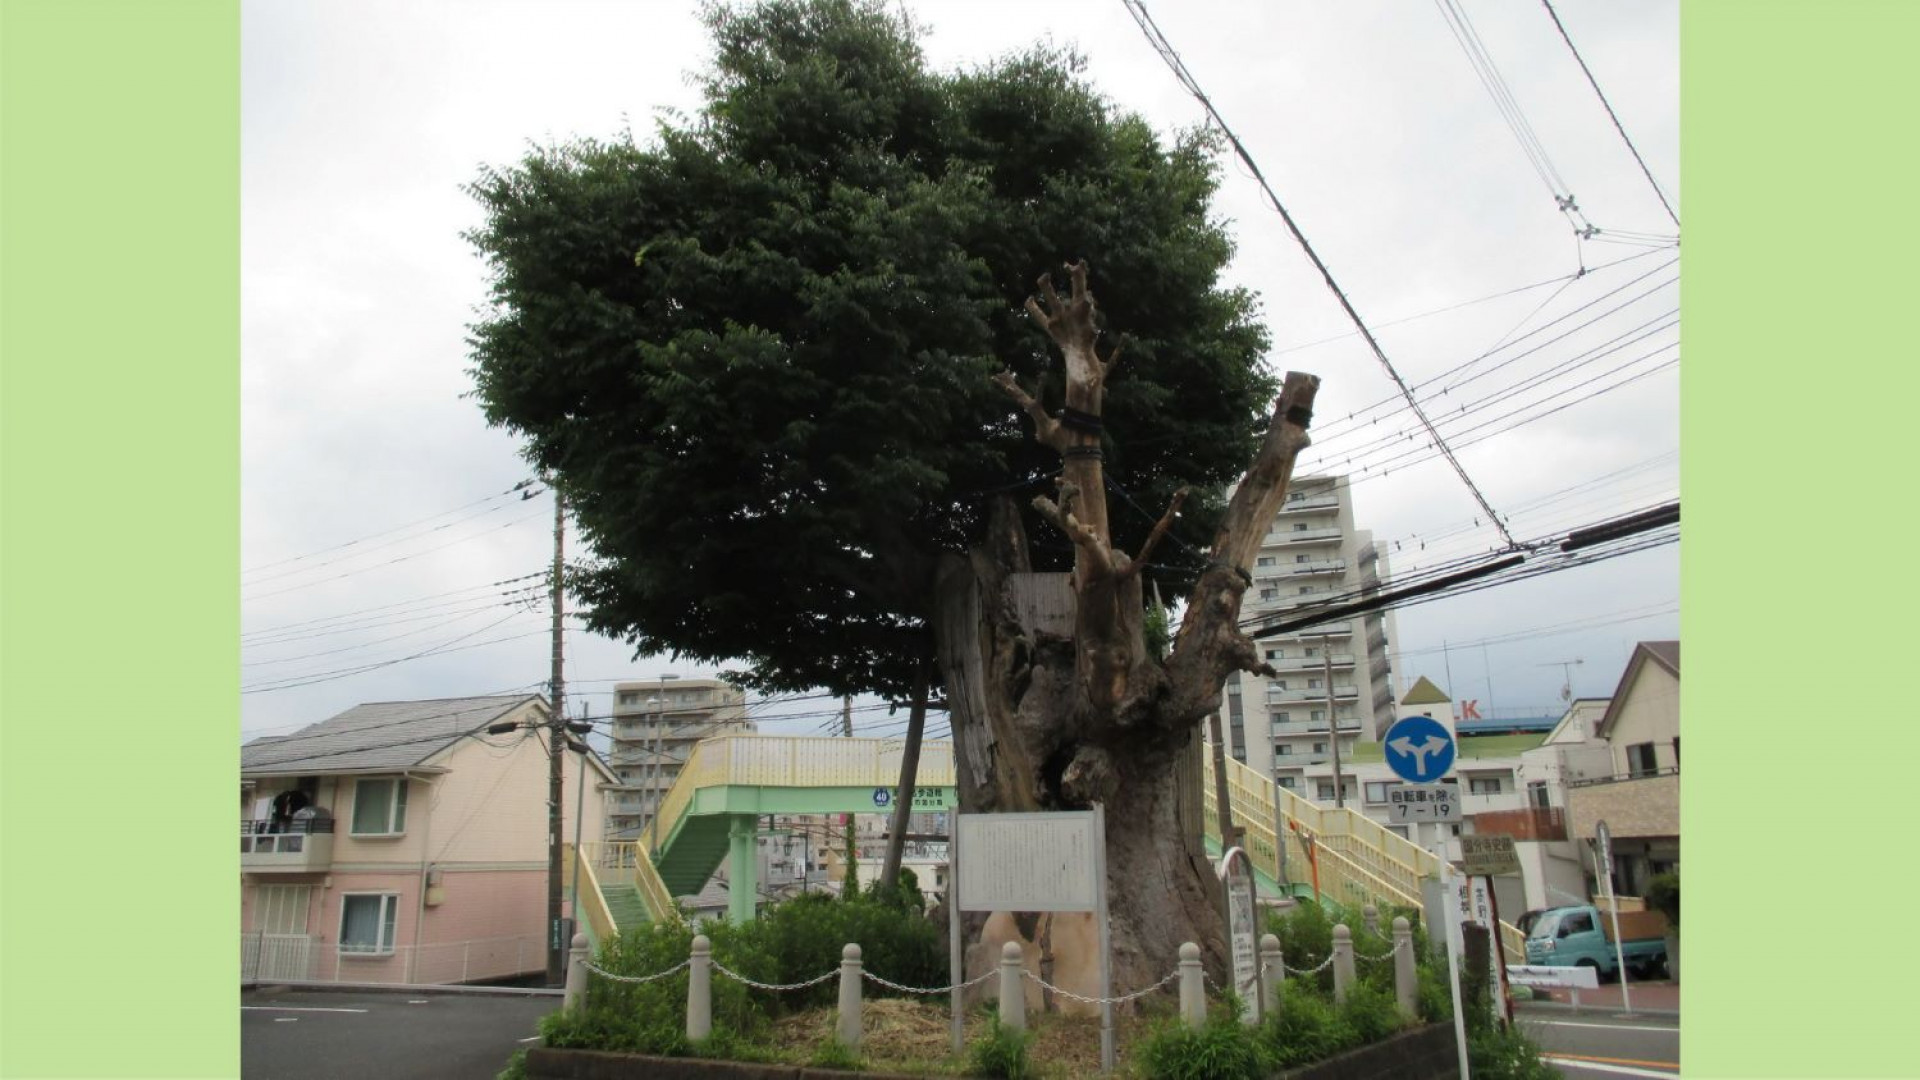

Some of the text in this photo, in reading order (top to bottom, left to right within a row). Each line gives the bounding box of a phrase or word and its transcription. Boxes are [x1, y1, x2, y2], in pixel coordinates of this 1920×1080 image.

[876, 791, 887, 802] 40
[1391, 789, 1456, 802] 自転車を除く
